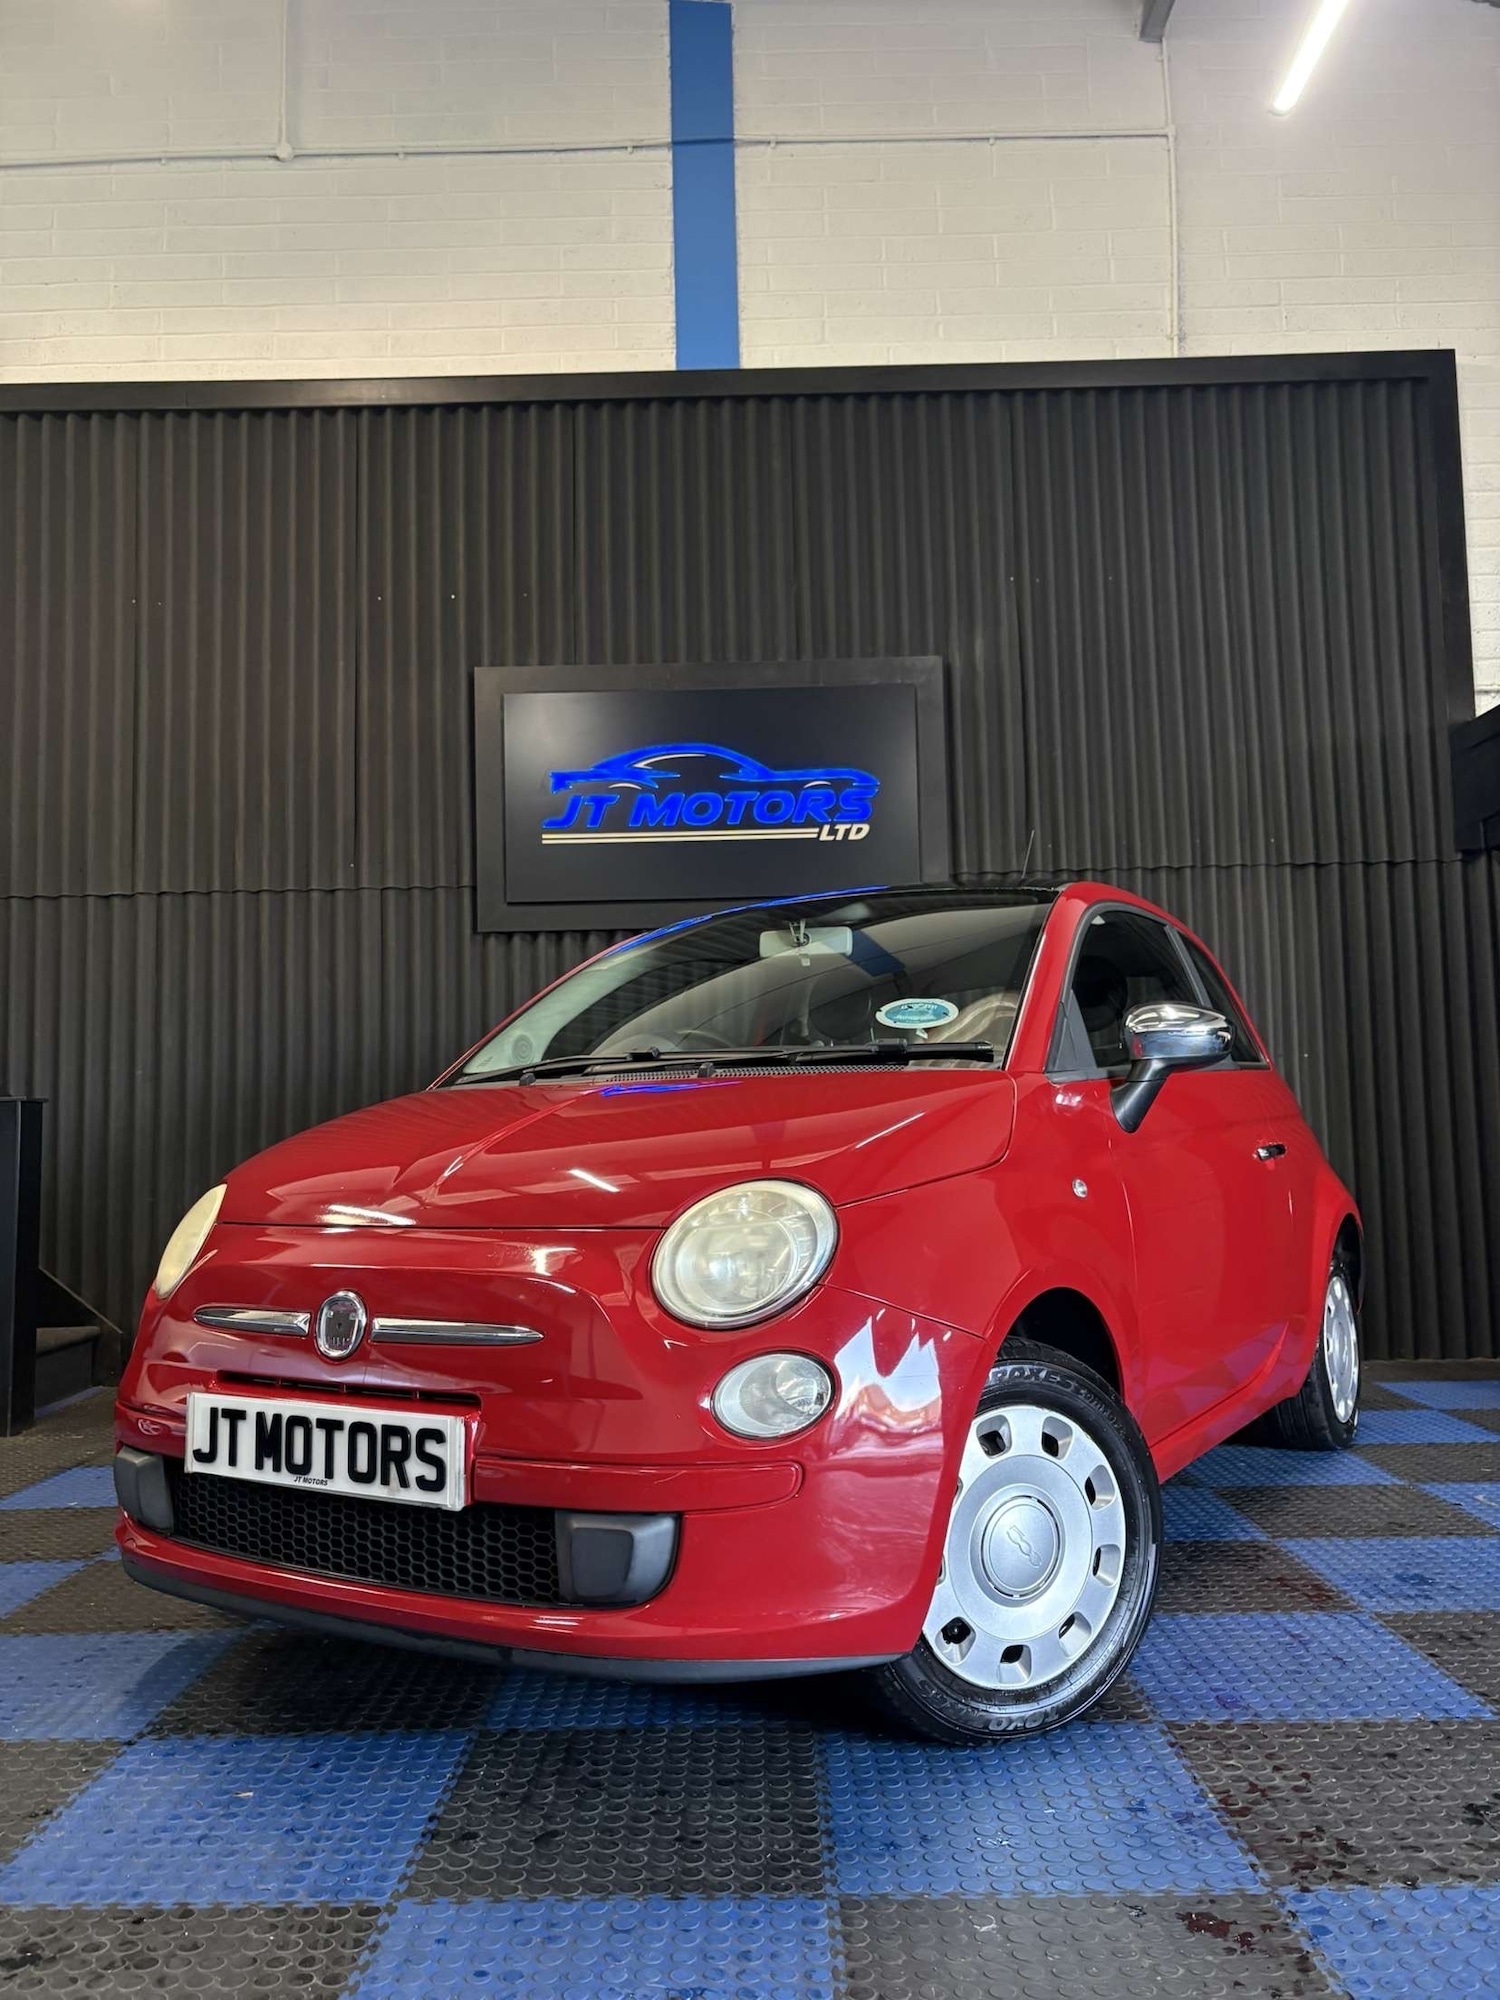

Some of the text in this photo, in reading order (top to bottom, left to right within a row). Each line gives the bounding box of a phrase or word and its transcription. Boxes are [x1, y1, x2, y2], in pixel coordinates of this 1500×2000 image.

[541, 788, 879, 829] JT MOTORS
[818, 823, 871, 841] LTD
[192, 1406, 447, 1492] JT MOTORS
[303, 1476, 328, 1486] MOTORS
